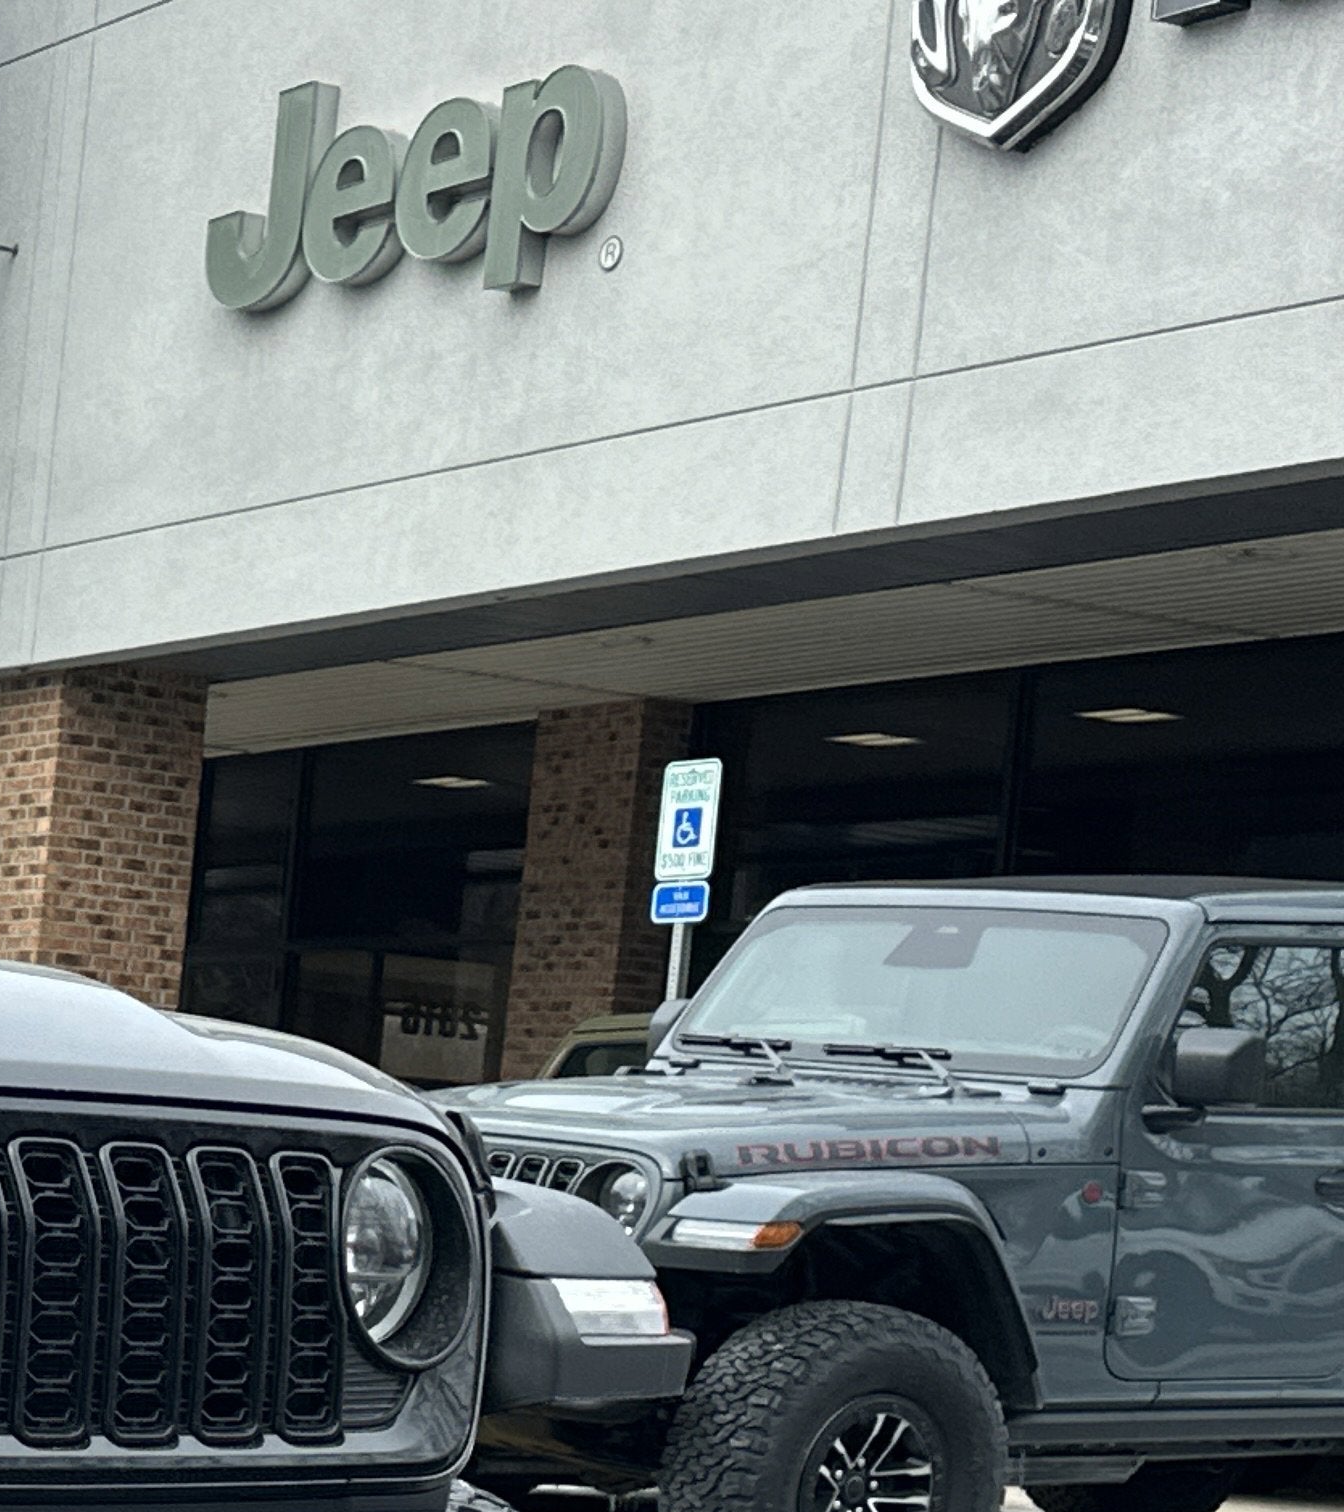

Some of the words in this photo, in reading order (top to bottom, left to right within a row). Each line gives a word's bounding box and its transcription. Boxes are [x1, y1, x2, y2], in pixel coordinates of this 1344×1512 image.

[206, 64, 628, 312] Jeep
[670, 788, 710, 804] PARKING
[736, 1135, 1000, 1167] RUBICON
[1042, 1295, 1099, 1323] Jeep
